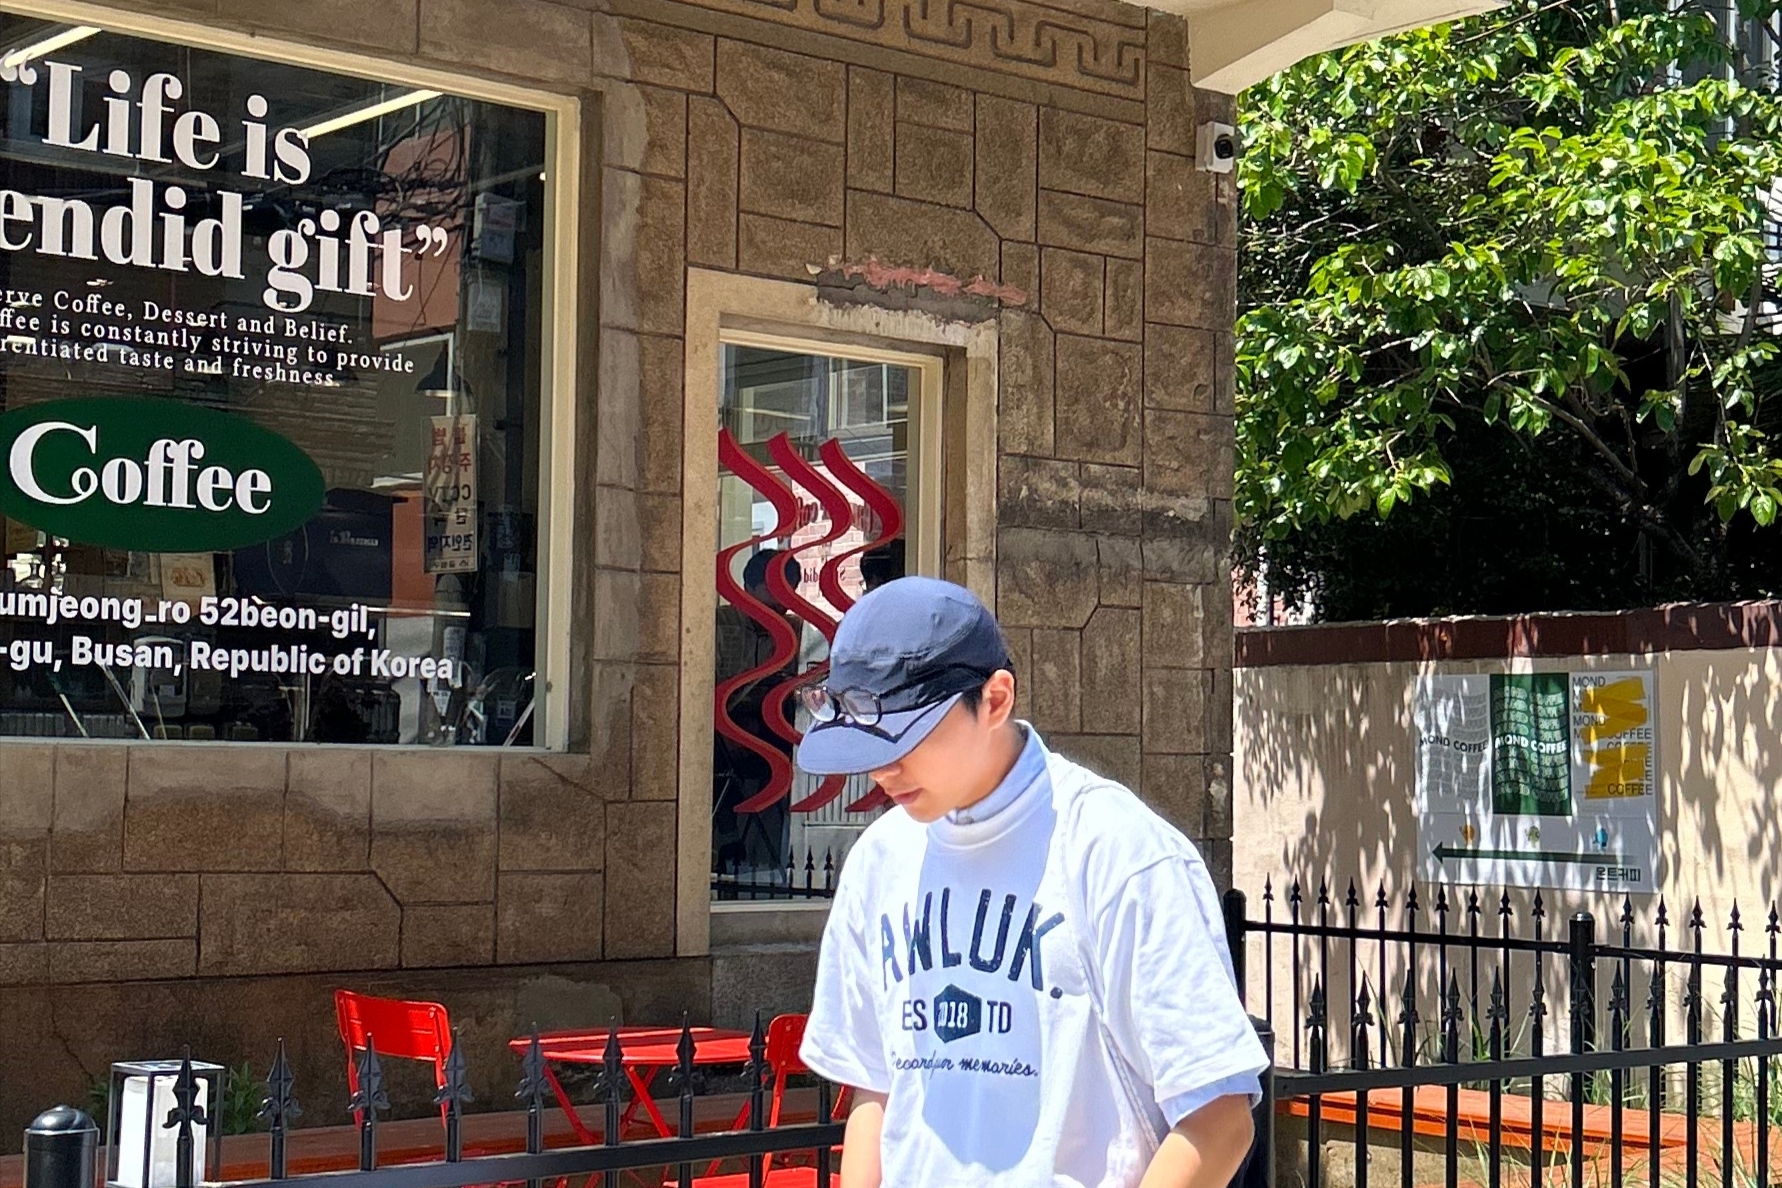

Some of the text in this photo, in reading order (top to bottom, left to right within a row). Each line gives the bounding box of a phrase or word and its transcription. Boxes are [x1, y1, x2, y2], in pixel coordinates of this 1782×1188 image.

[241, 94, 311, 185] is
[0, 176, 449, 313] endid gift”
[0, 290, 353, 345] rve Coffee, Dessert and Belief.
[51, 313, 71, 334] is
[80, 322, 202, 354] constantly
[211, 336, 298, 366] striving
[307, 345, 328, 364] to
[336, 351, 414, 374] provide
[120, 346, 174, 370] taste
[184, 355, 223, 375] and
[232, 357, 340, 387] freshness.
[9, 421, 273, 514] Coffee
[199, 596, 375, 641] 52beon-gil,
[71, 635, 182, 677] Busan,
[190, 640, 326, 679] Republic
[332, 647, 364, 676] of
[370, 649, 454, 678] Korea
[1572, 676, 1606, 688] MOND
[1495, 734, 1567, 755] MOND COFFEE
[1607, 783, 1653, 796] COFFEE
